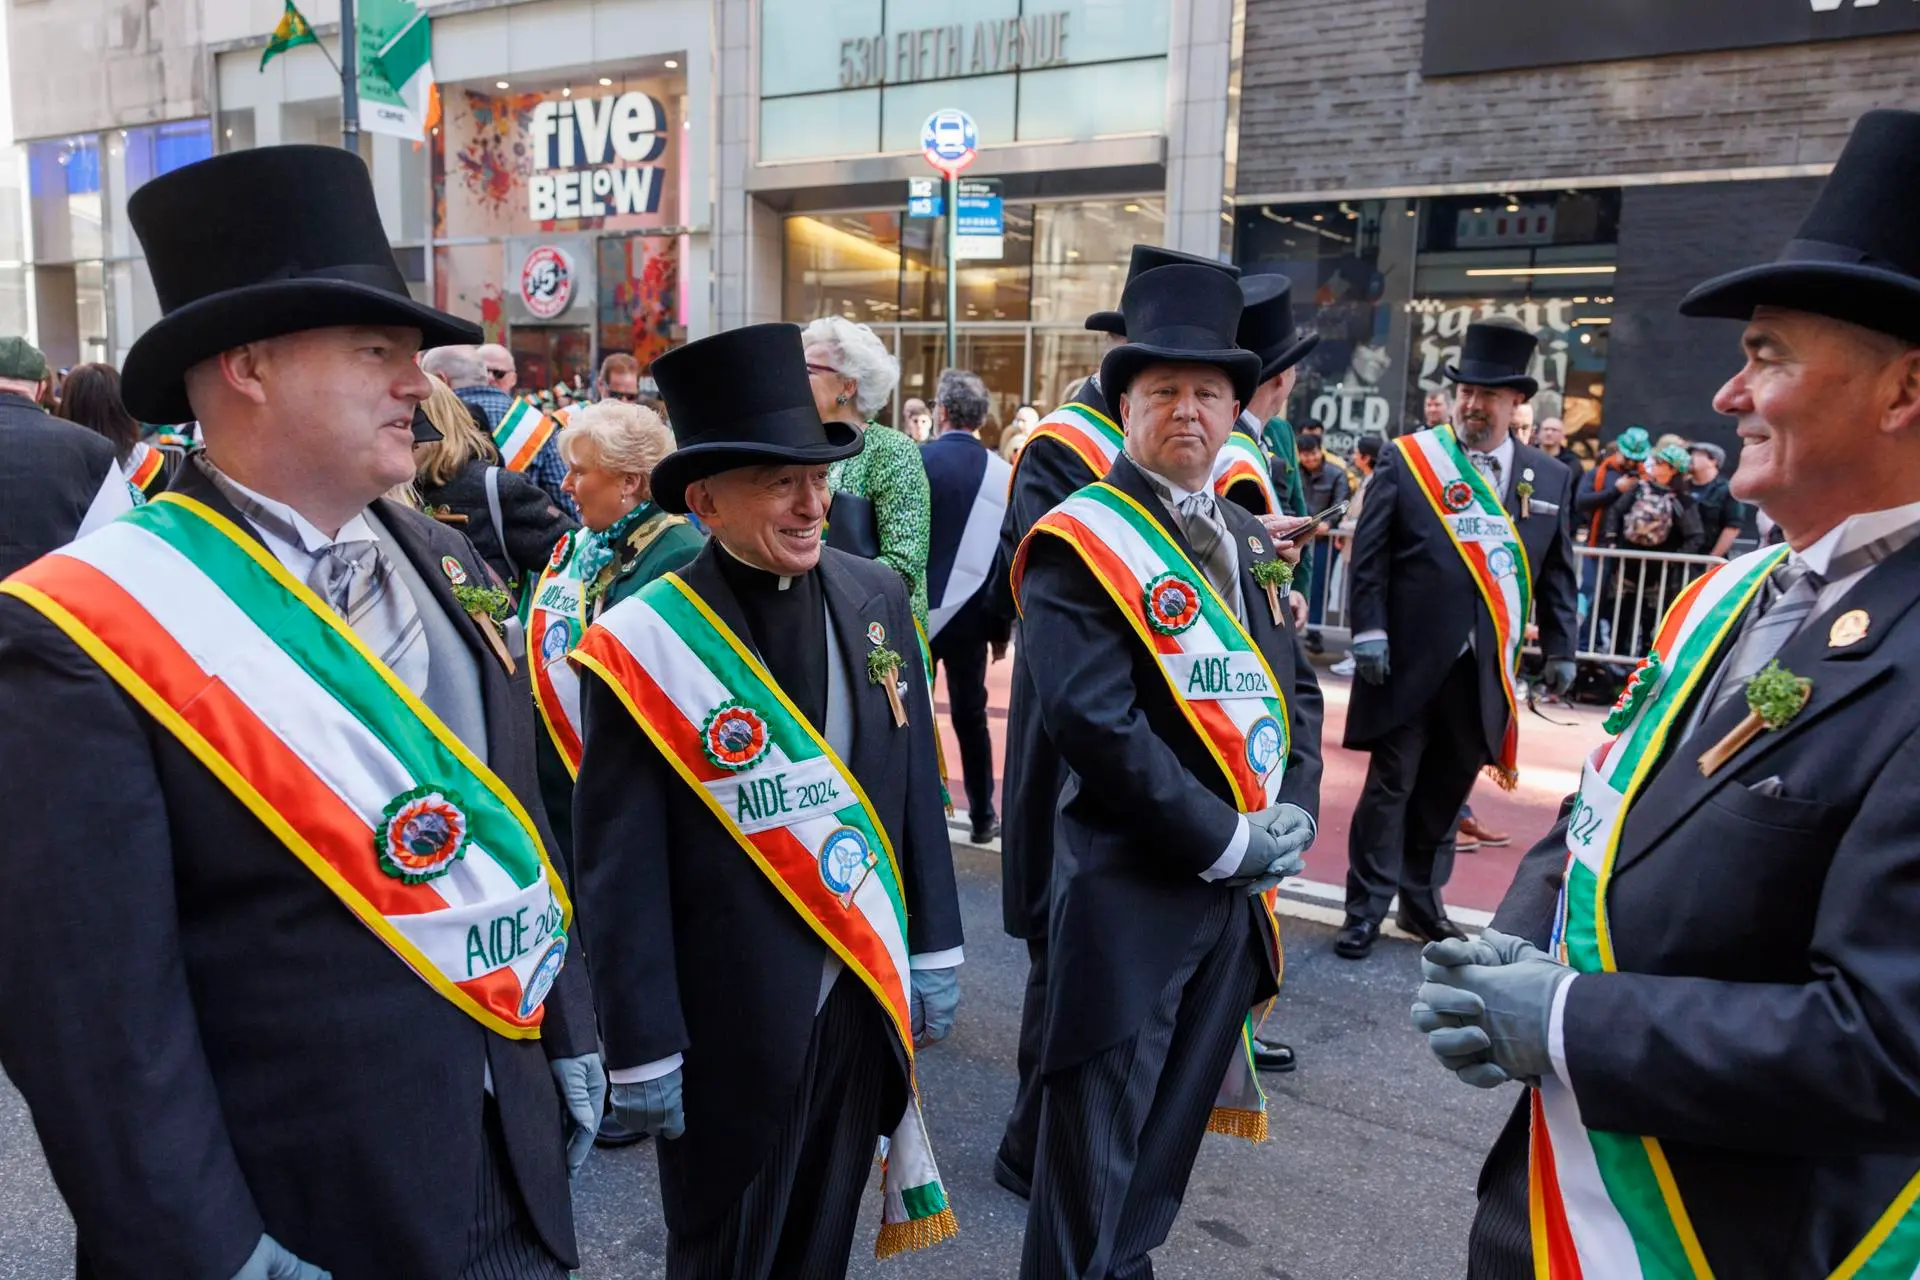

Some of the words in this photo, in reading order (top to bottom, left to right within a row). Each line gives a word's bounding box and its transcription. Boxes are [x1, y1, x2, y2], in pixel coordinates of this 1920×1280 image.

[839, 36, 887, 88] 530
[895, 24, 963, 80] FIFTH
[971, 11, 1070, 72] AVENUE
[528, 91, 667, 170] five
[528, 165, 665, 222] BELOW
[1310, 395, 1390, 432] OLD
[537, 584, 565, 609] AIDE
[1188, 656, 1233, 693] AIDE
[1235, 672, 1268, 692] 2024
[737, 773, 792, 823] AIDE
[796, 779, 840, 809] 2024
[467, 906, 529, 977] AIDE
